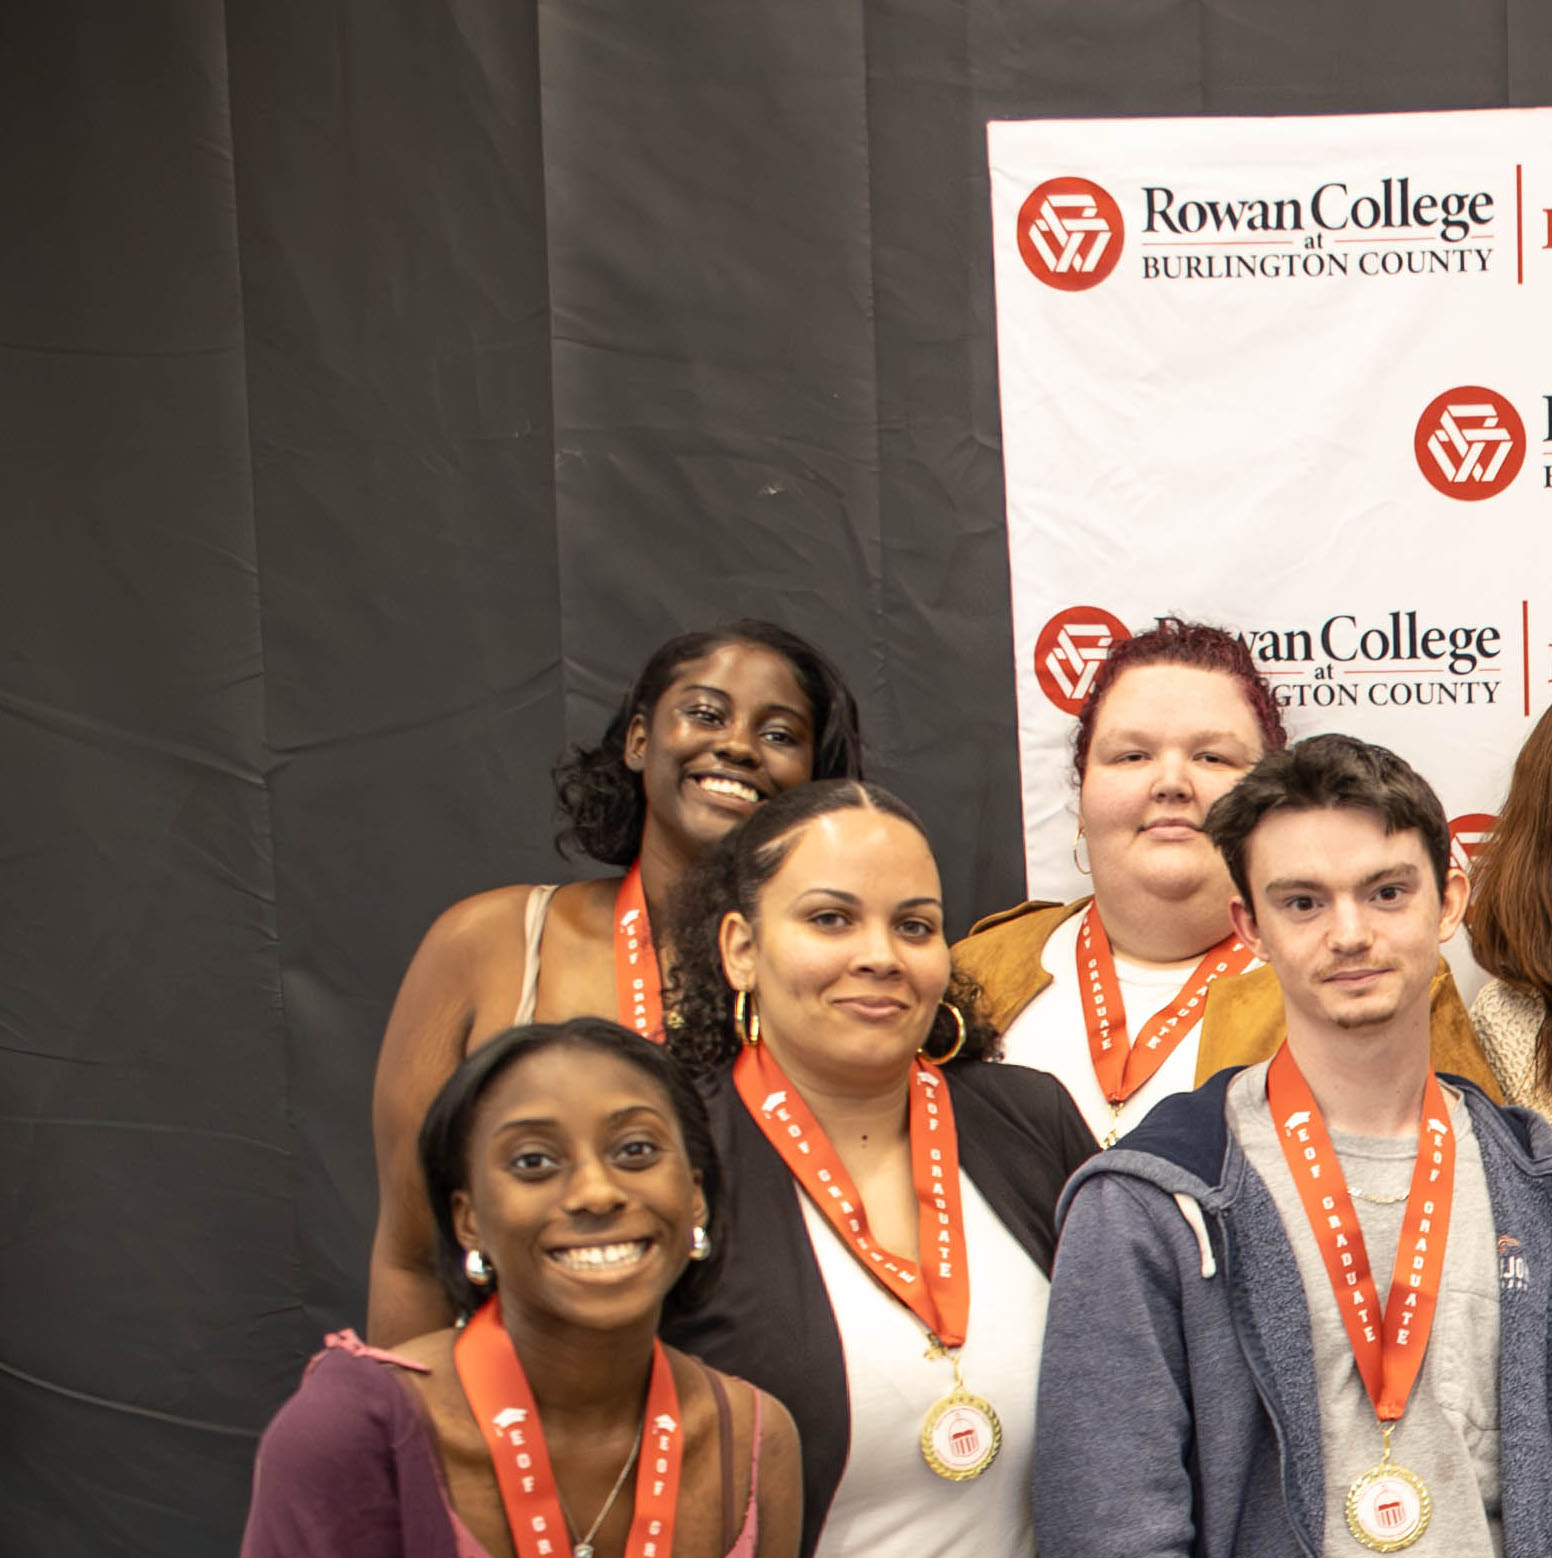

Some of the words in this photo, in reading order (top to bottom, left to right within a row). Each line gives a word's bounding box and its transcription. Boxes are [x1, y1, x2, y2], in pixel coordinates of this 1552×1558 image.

[1143, 188, 1302, 233] Rowan
[1310, 178, 1493, 242] College
[1304, 233, 1323, 249] at
[1143, 255, 1348, 278] BURLINGTON
[1360, 250, 1493, 275] COUNTY
[1313, 664, 1334, 680] at
[1320, 612, 1501, 674] College
[1367, 681, 1501, 707] COUNTY
[1088, 958, 1112, 1051] GRADUATE
[925, 1087, 938, 1131] EOF
[1429, 1134, 1444, 1183] EOF
[776, 1107, 811, 1154] EOF
[817, 1169, 917, 1283] GRADUATE
[930, 1148, 953, 1279] GRADUATE
[1297, 1128, 1321, 1179] EOF
[1322, 1196, 1376, 1342] GRADUATE
[1397, 1200, 1435, 1345] GRADUATE
[511, 1430, 534, 1492] EOF
[653, 1436, 670, 1496] EOF
